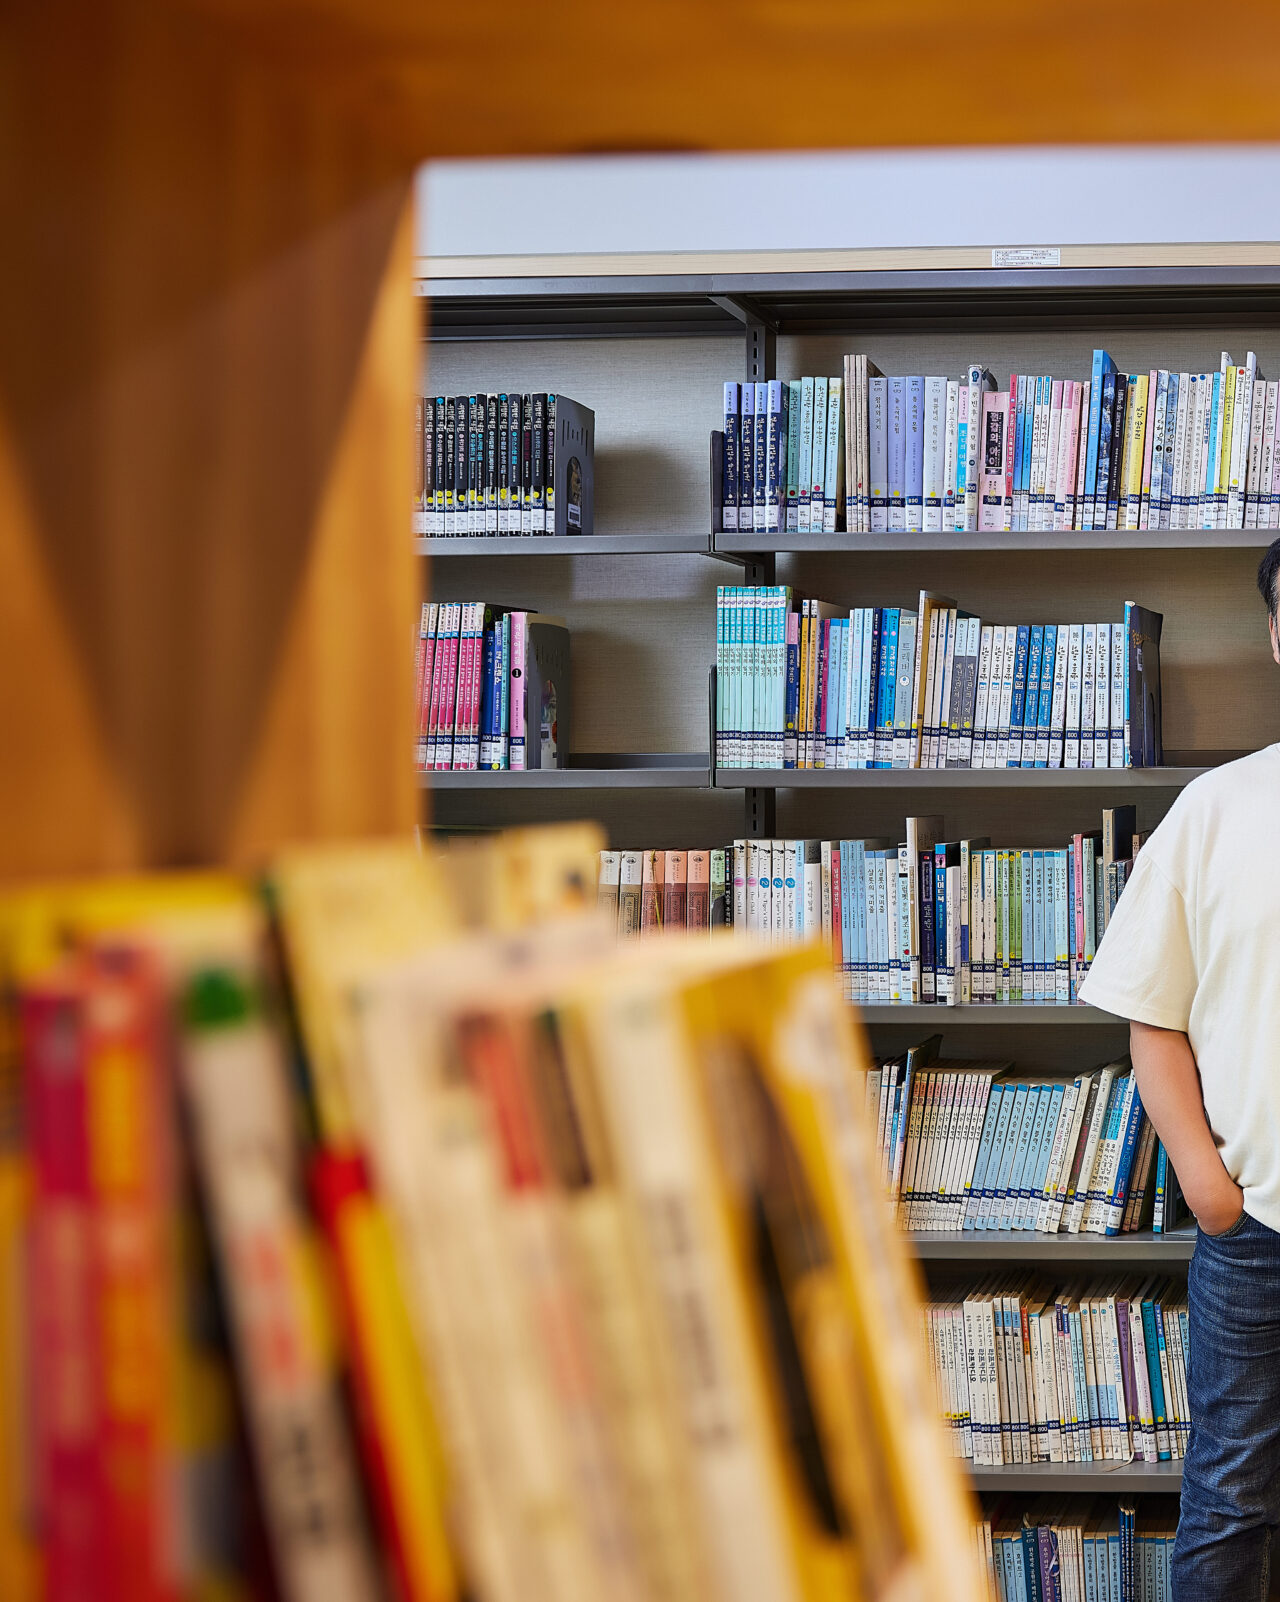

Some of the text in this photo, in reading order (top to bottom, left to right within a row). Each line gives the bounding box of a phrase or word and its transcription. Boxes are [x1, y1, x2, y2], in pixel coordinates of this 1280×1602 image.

[968, 1348, 977, 1383] 라프카디오
[978, 1348, 987, 1383] 라프카디오
[988, 1348, 996, 1383] 라프카디오
